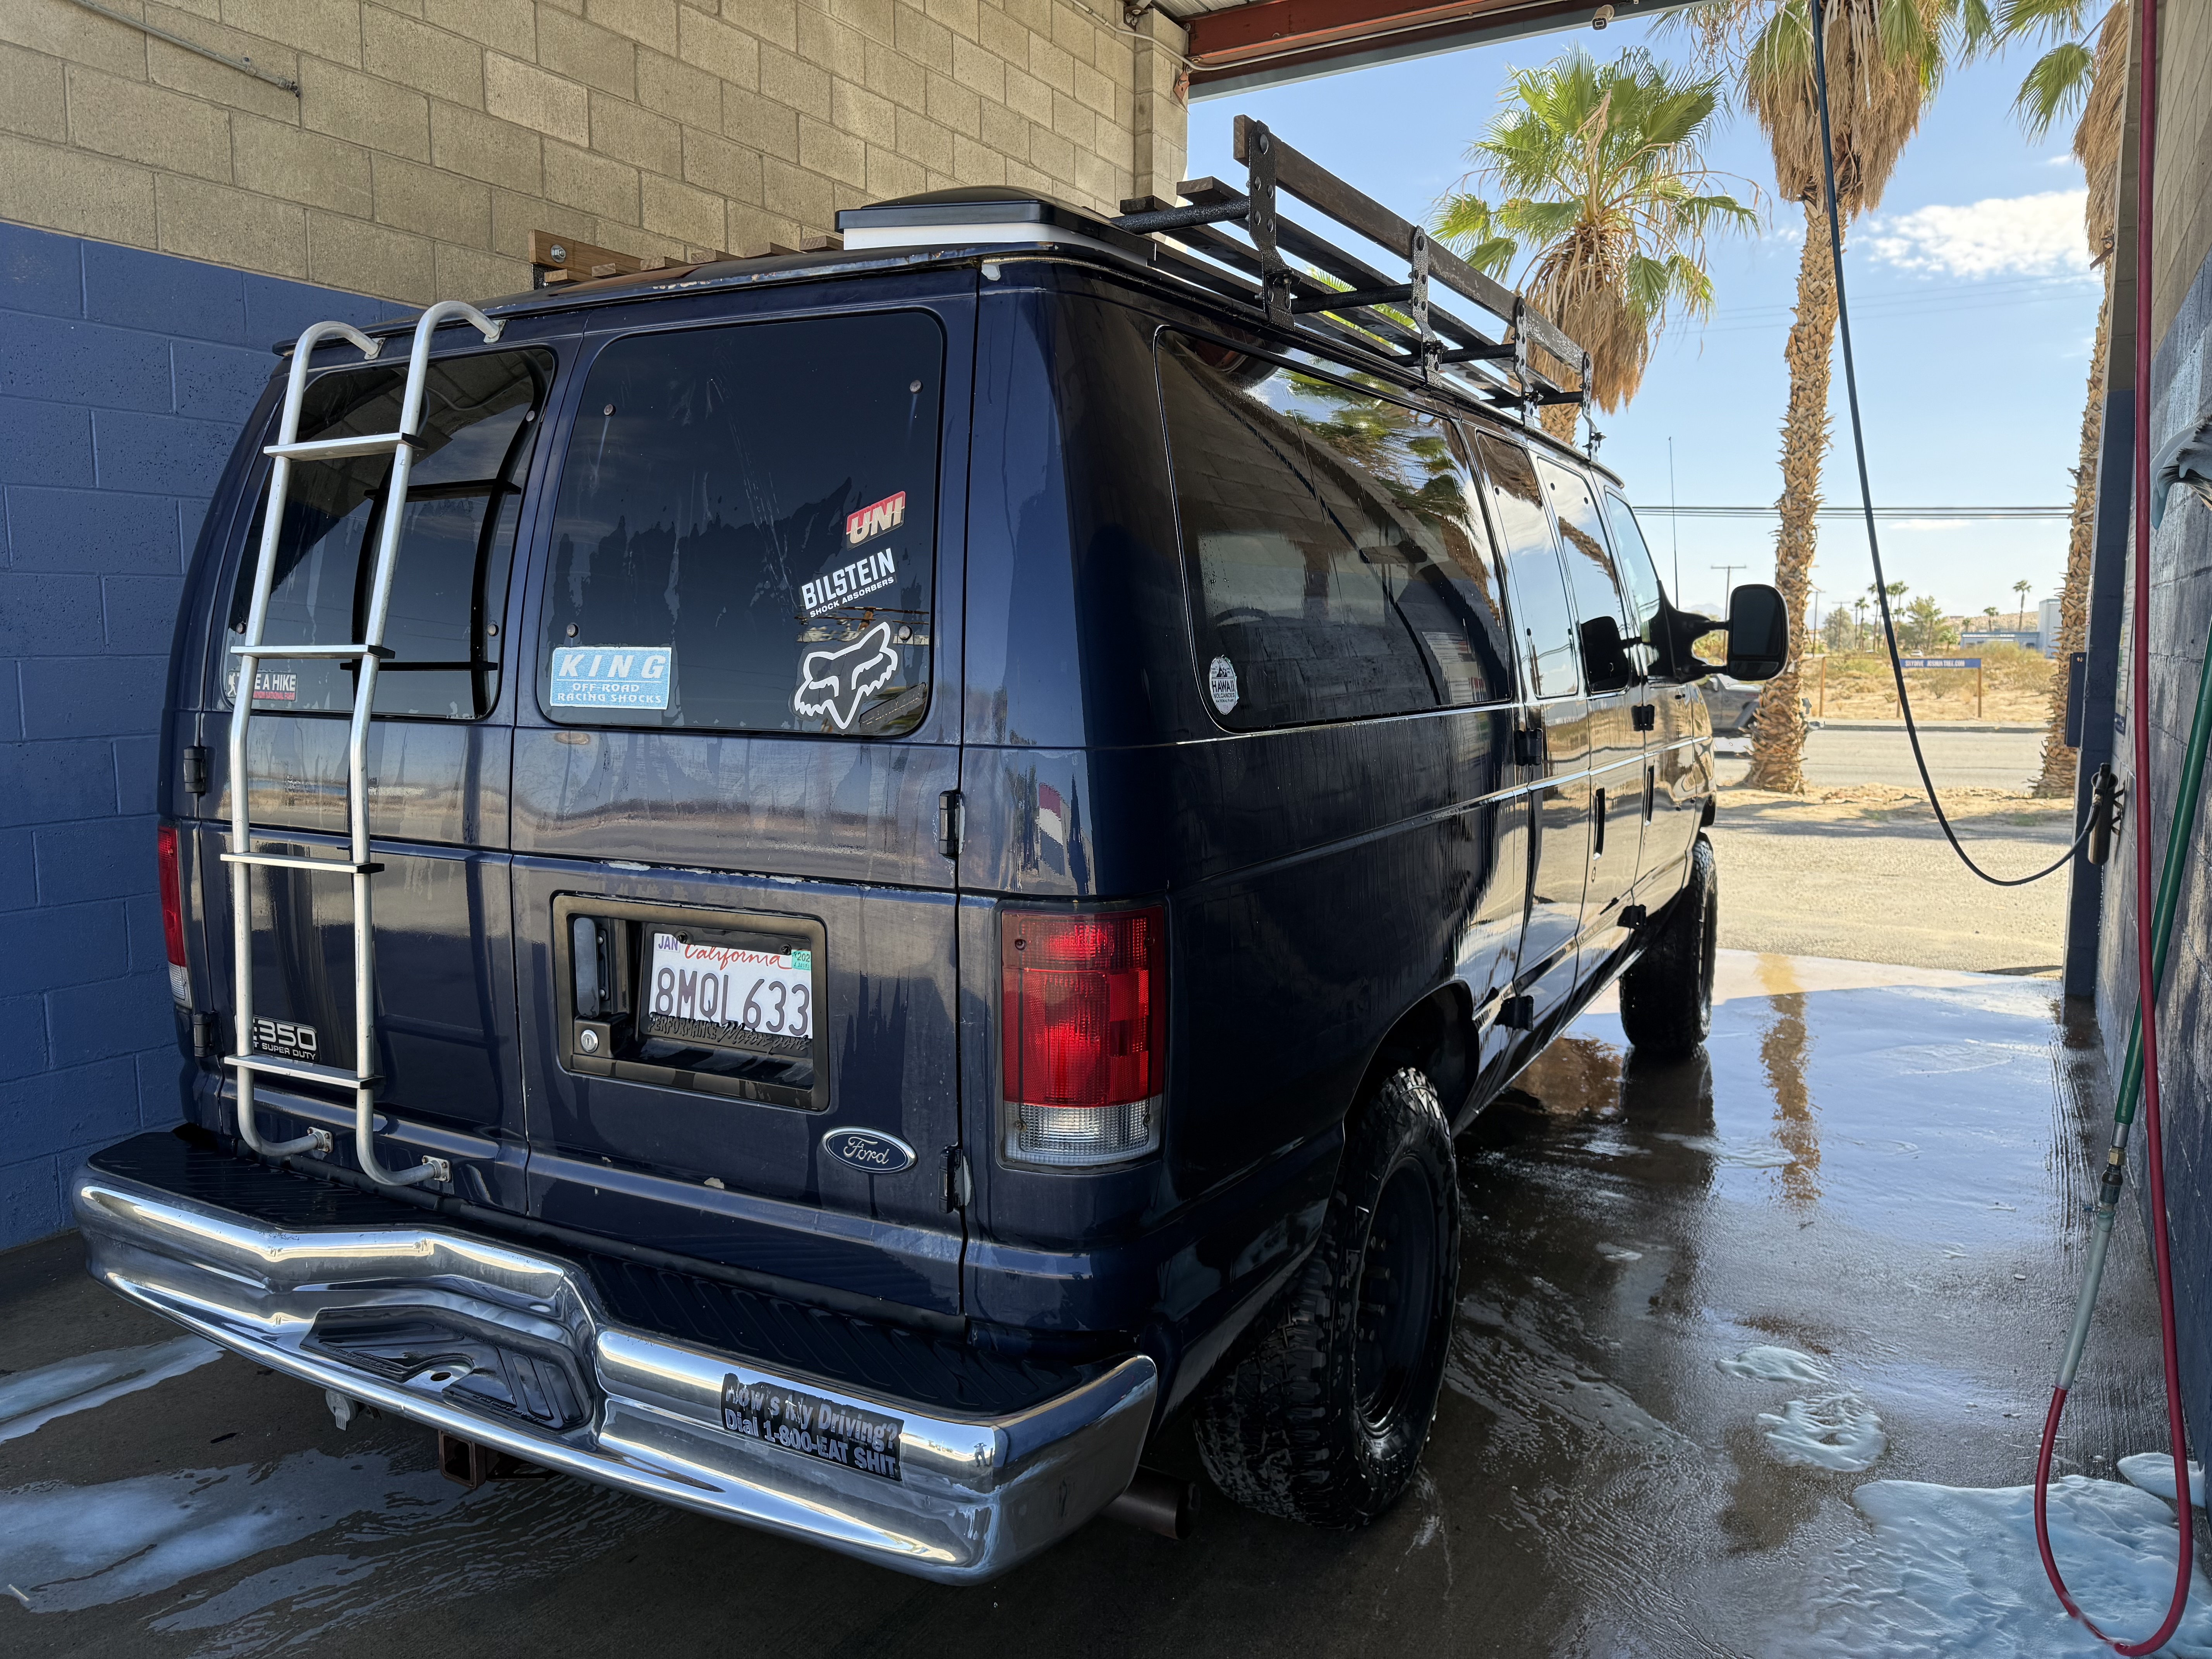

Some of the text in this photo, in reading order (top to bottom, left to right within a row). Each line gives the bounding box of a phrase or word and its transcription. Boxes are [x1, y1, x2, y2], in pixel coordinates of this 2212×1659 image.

[850, 496, 903, 544] UNI
[802, 548, 895, 610] BILSTEIN
[810, 577, 894, 618] SHOCK ABSORBERS
[559, 654, 666, 678] KING
[262, 674, 270, 690] A
[272, 674, 297, 691] HIKE
[572, 683, 640, 693] OFF-ROAD
[1212, 680, 1235, 693] HAWAII
[558, 692, 661, 704] RACING SHOCKS
[658, 936, 678, 951] JAN
[685, 944, 792, 970] California
[655, 967, 810, 1036] 8MQL633
[253, 1018, 317, 1051] 350
[648, 1012, 717, 1039] PERFORMANCE
[262, 1042, 290, 1055] SUPER
[292, 1049, 316, 1060] DUTY
[843, 1137, 890, 1164] Ford
[818, 1403, 898, 1452] Driving?
[725, 1408, 896, 1476] Dial 1-800-EAT SHIT
